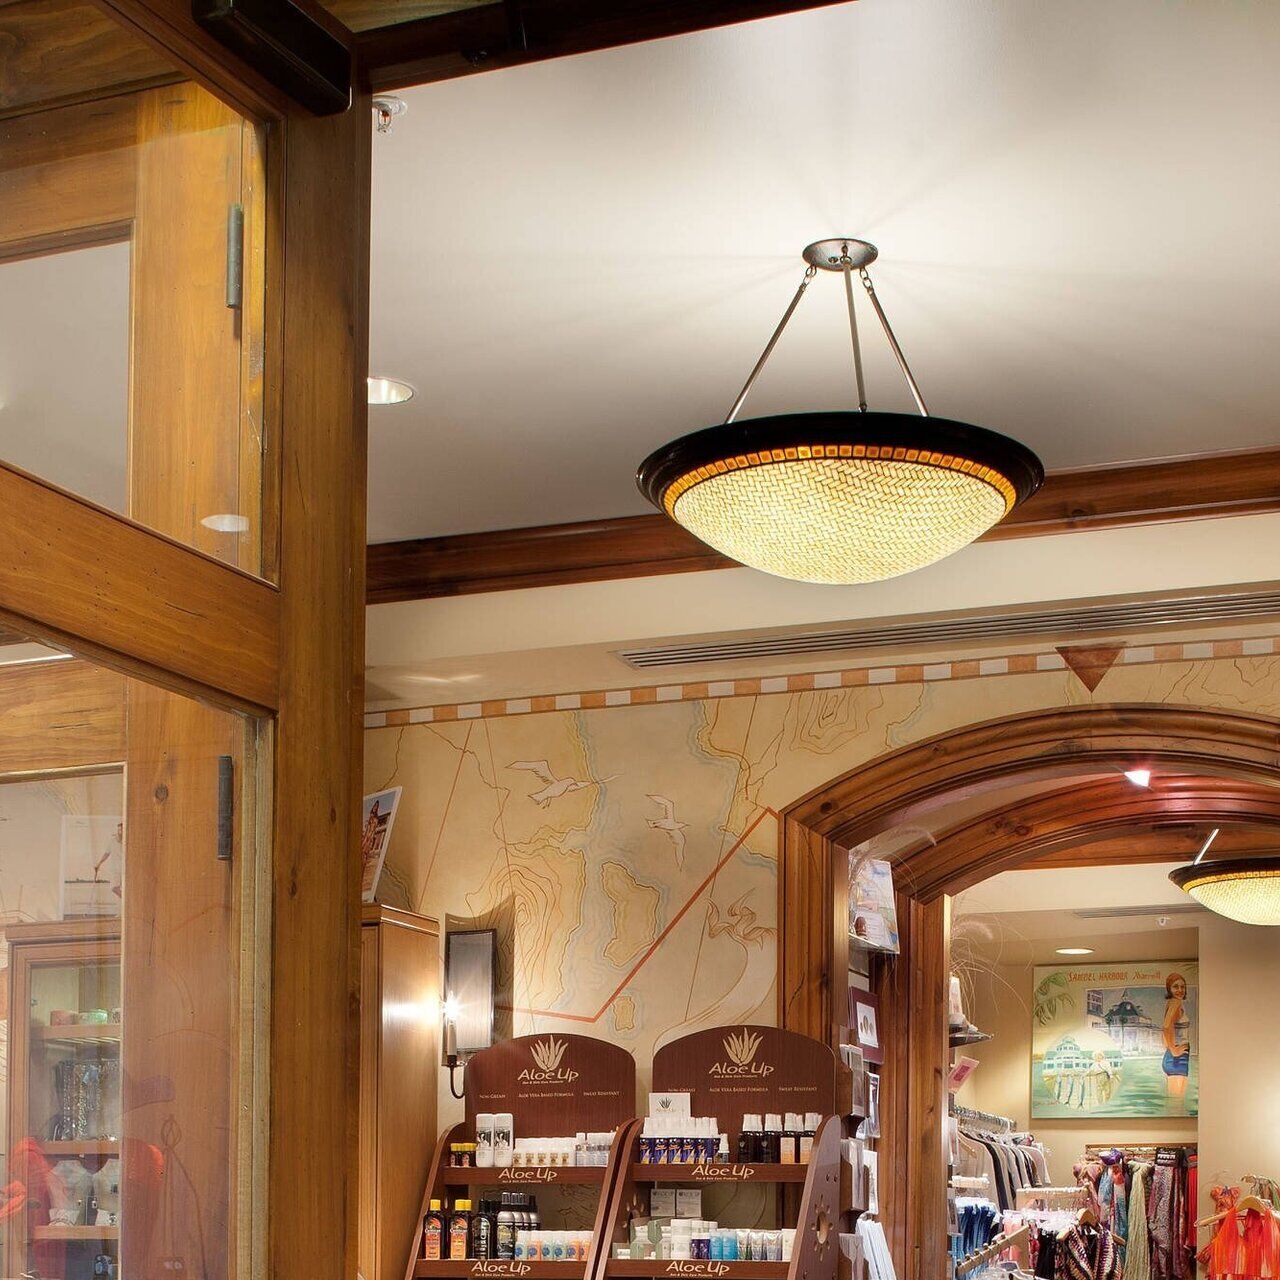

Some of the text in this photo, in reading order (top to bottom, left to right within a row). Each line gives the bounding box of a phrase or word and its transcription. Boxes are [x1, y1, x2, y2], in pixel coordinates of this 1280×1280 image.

[517, 1068, 579, 1083] Aloe Up
[708, 1062, 774, 1077] Aloe Up
[498, 1168, 558, 1182] Aloe Up
[691, 1164, 755, 1180] Aloe Up
[471, 1261, 531, 1276] Aloe Up
[666, 1261, 730, 1277] Aloe Up
